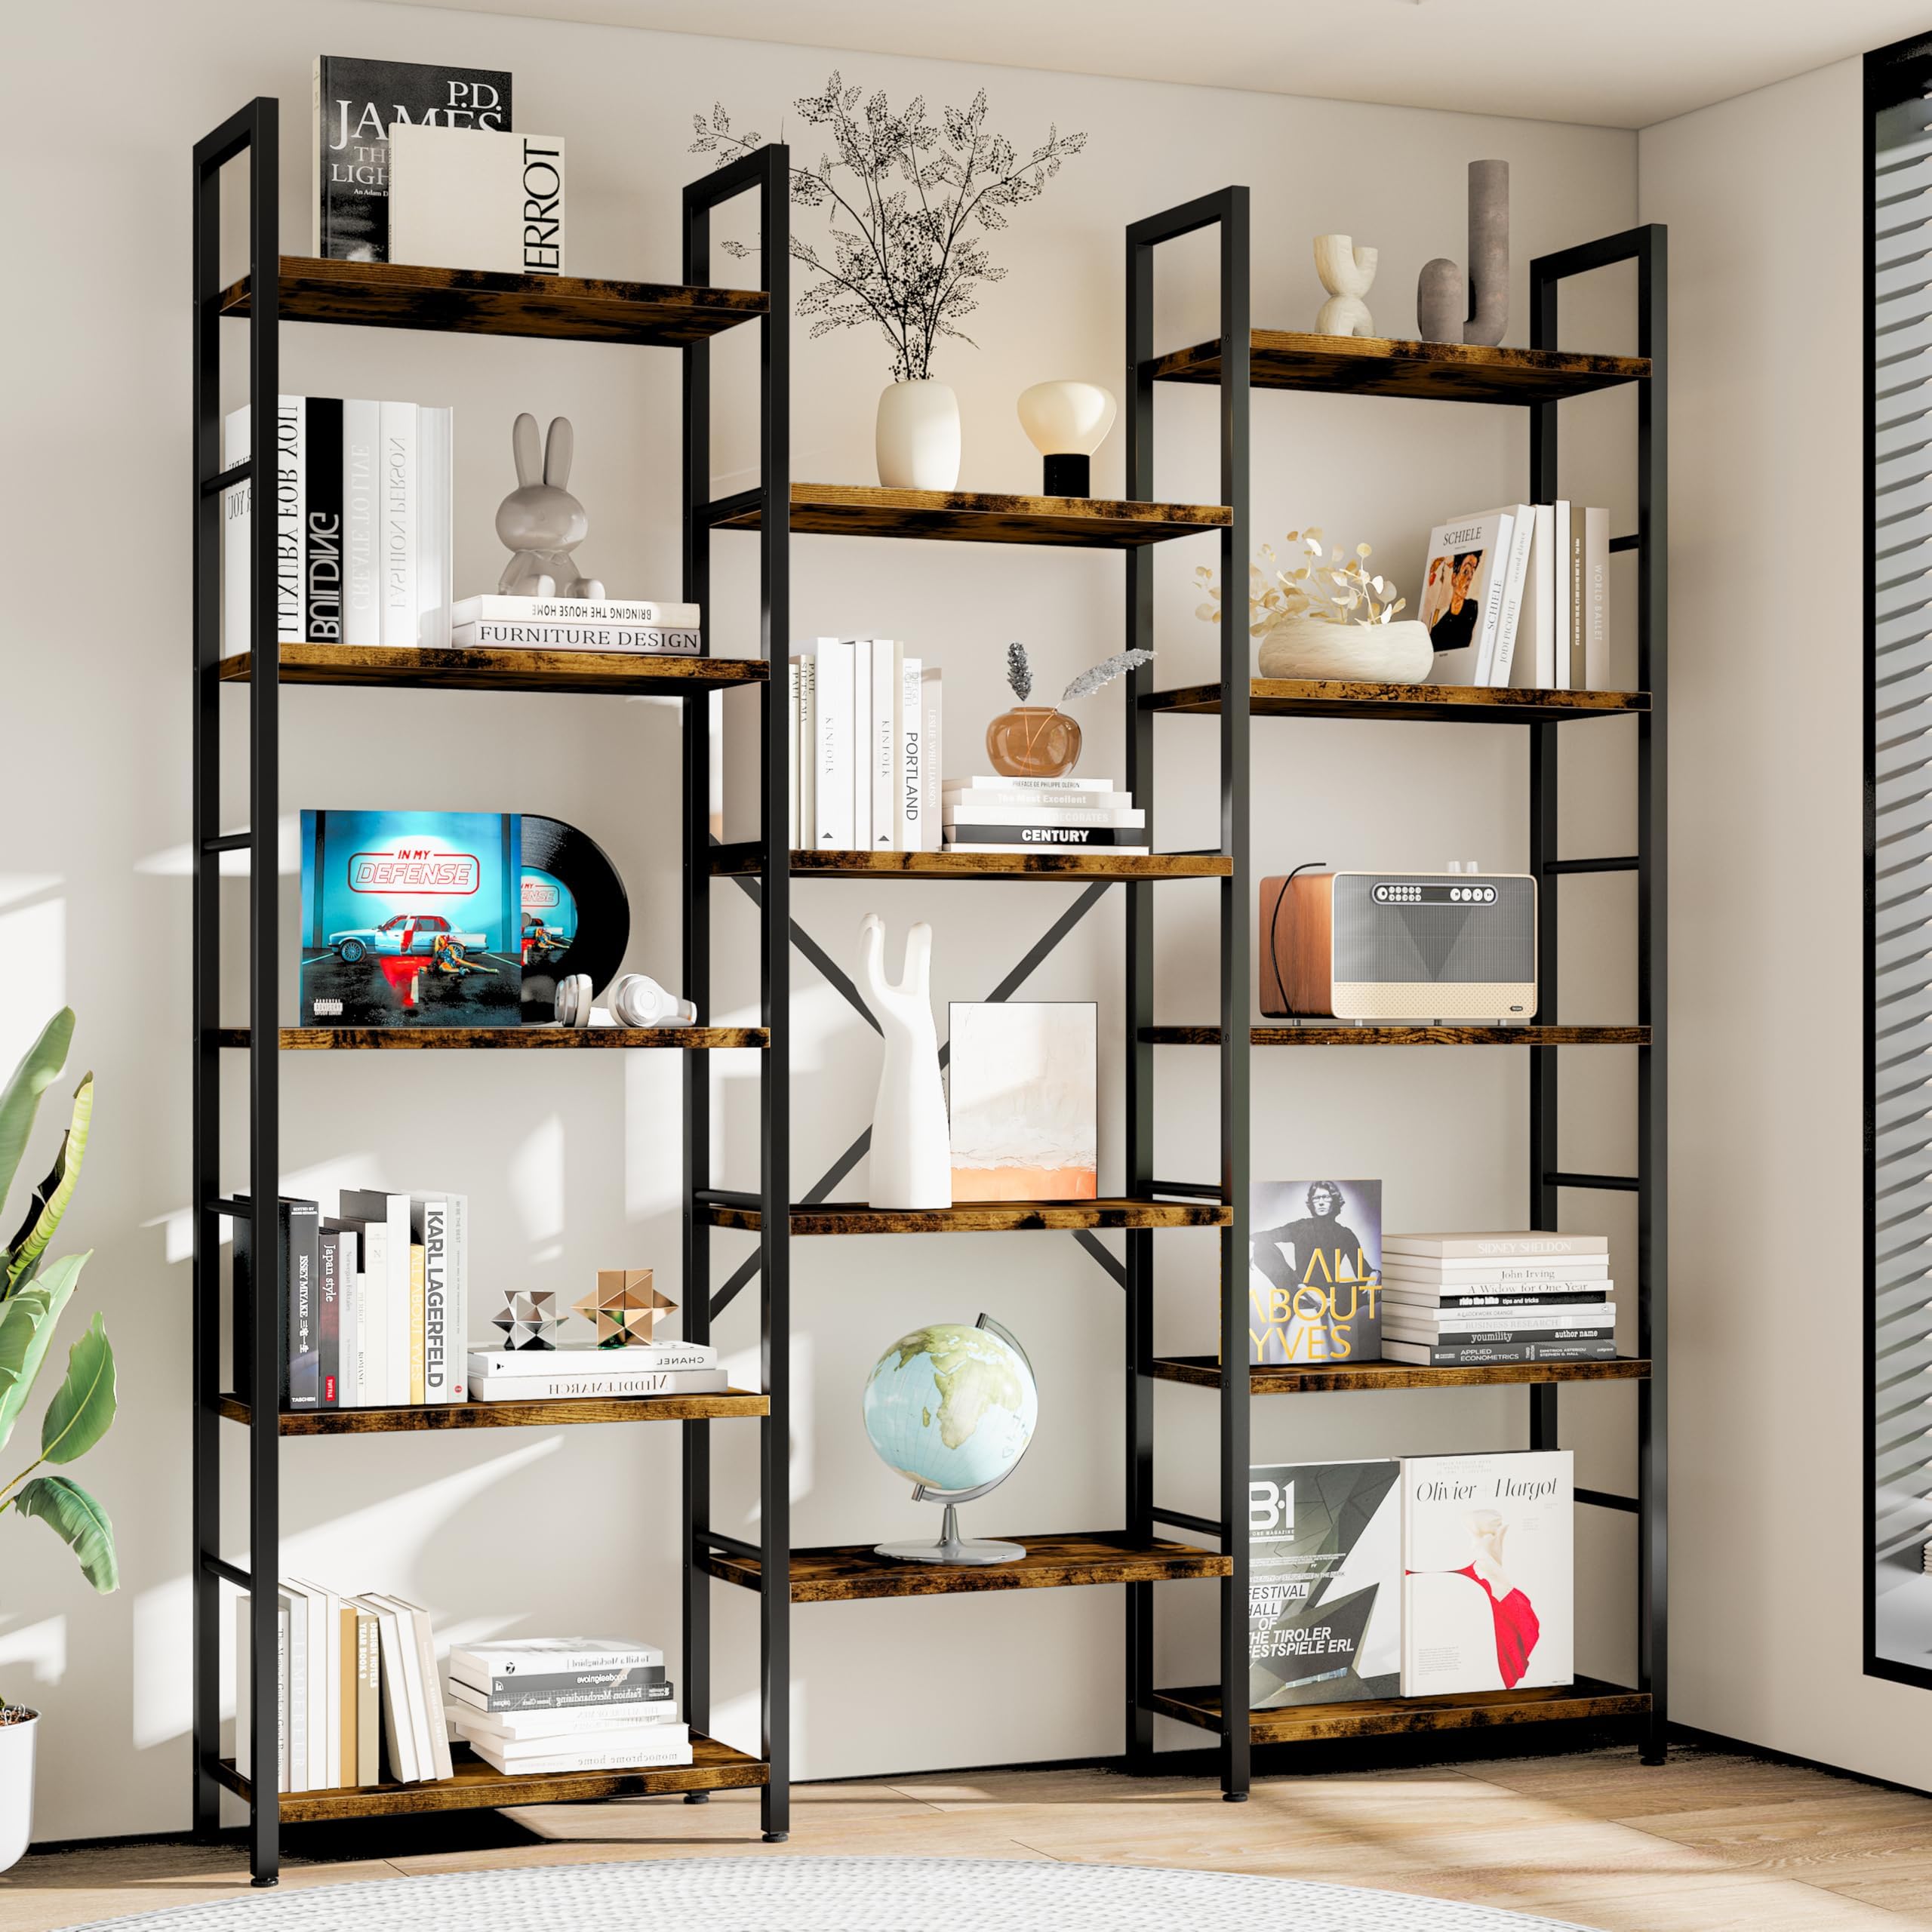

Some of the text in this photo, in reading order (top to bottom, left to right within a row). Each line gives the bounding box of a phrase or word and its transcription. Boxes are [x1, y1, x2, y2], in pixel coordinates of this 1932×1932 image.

[447, 80, 502, 111] P.D.
[1442, 526, 1482, 546] SCHIELE
[1513, 531, 1526, 583] second glance
[531, 604, 651, 620] BRINGING THE HOUSE HOME
[1487, 579, 1503, 630] SCHIELE
[1594, 564, 1602, 641] WORLD BALLET
[480, 626, 698, 648] FURNITURE DESIGN
[1499, 598, 1516, 663] JODI PICOULT
[826, 717, 834, 774] KINFOLK
[881, 720, 890, 777] KINFOLK
[906, 732, 918, 820] PORTLAND
[1021, 829, 1089, 842] CENTURY
[398, 849, 432, 860] IN MY
[356, 862, 472, 886] DEFENSE
[1478, 1241, 1572, 1255] SIDNEY SHELDON
[322, 1244, 336, 1303] Japan style
[1303, 1247, 1377, 1284] ALL
[1501, 1269, 1555, 1281] John Irving
[300, 1254, 309, 1318] ISSEY MIYAKE
[1467, 1282, 1588, 1294] A Widow for One Year
[411, 1282, 423, 1334] ABOUT
[427, 1211, 443, 1388] KARL LAGERFELD
[1465, 1320, 1511, 1330] BUSINESS
[1512, 1318, 1558, 1328] RESEARCH
[1249, 1324, 1352, 1362] YVES
[1471, 1330, 1598, 1343] youmility author name
[1460, 1353, 1519, 1361] ECONOMETRICS
[1417, 1481, 1477, 1502] Olivier
[1259, 1617, 1278, 1631] OF
[1273, 1627, 1331, 1643] TIROLER
[370, 1622, 378, 1688] DESIGN HOTELS
[1328, 1638, 1355, 1653] ERL
